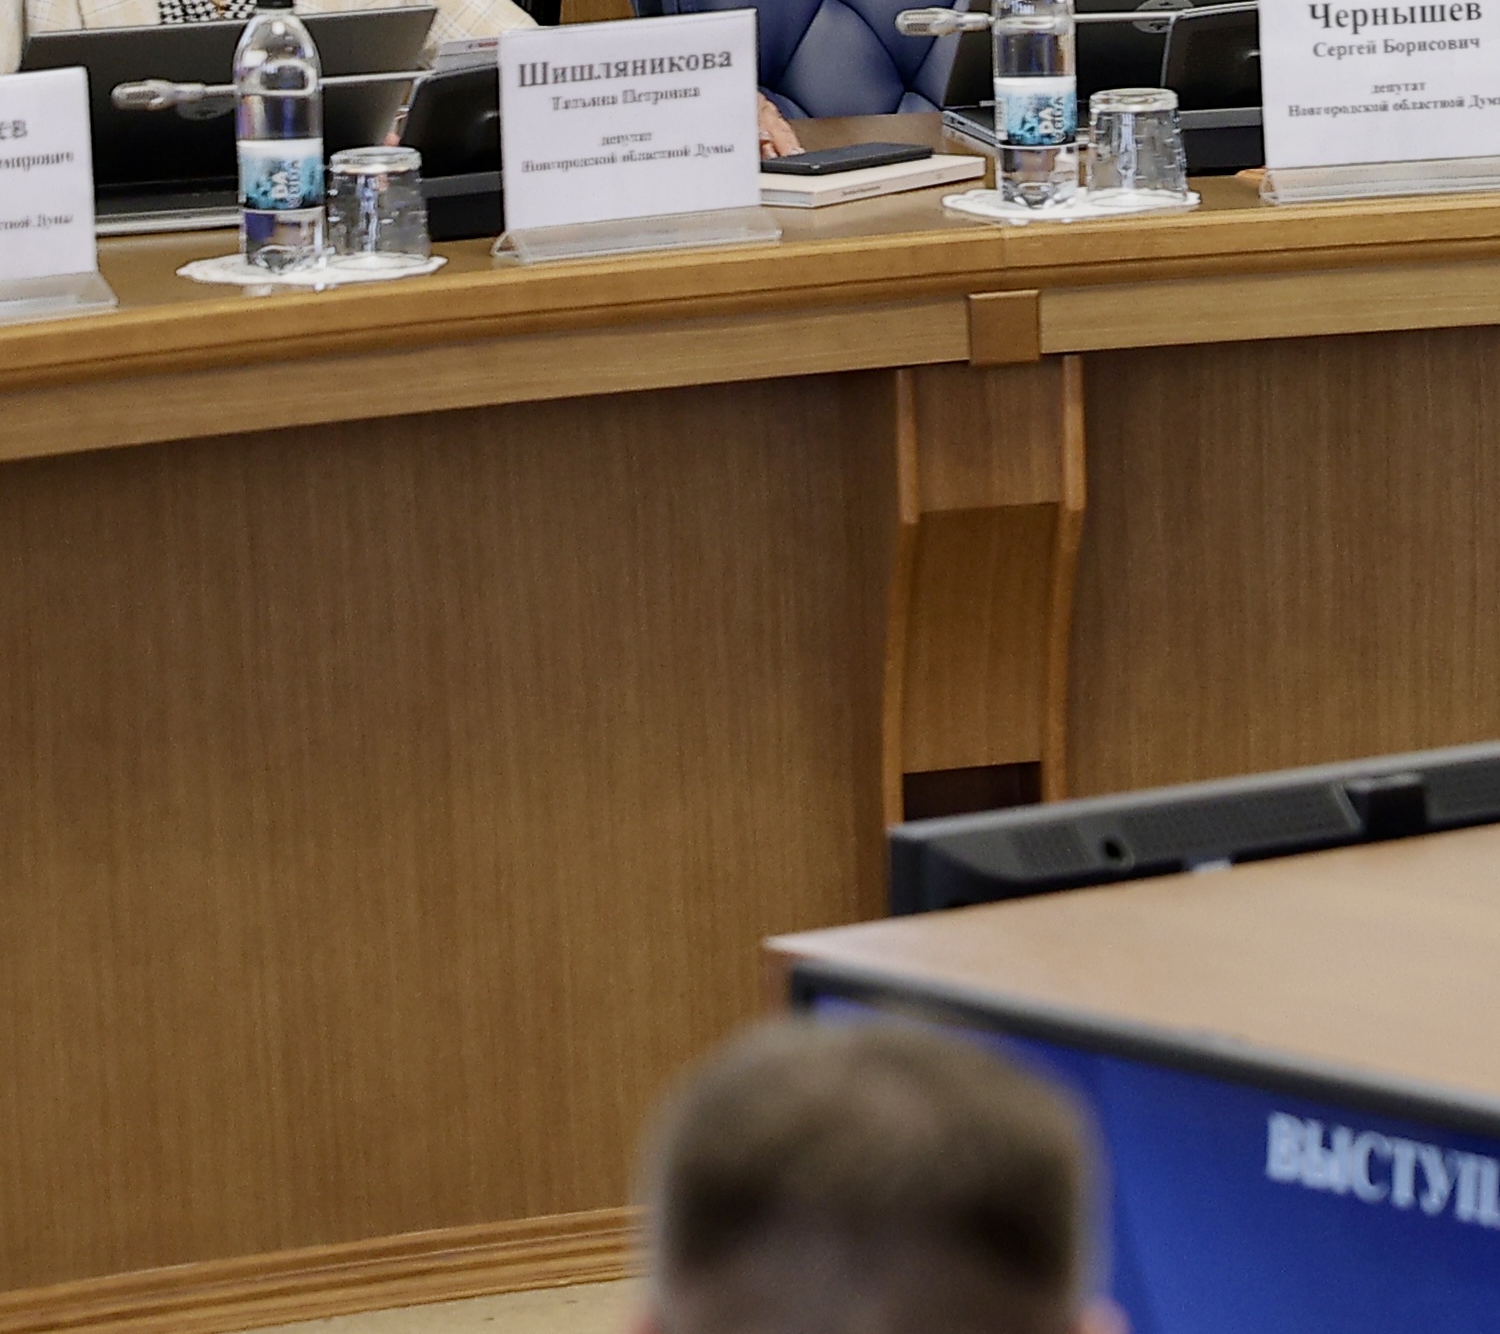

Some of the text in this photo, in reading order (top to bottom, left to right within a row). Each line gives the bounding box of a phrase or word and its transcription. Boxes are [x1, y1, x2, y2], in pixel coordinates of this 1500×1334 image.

[1307, 1, 1483, 34] Чернышев
[1313, 37, 1481, 60] Сергей Борисович
[518, 51, 733, 87] Шишляникова
